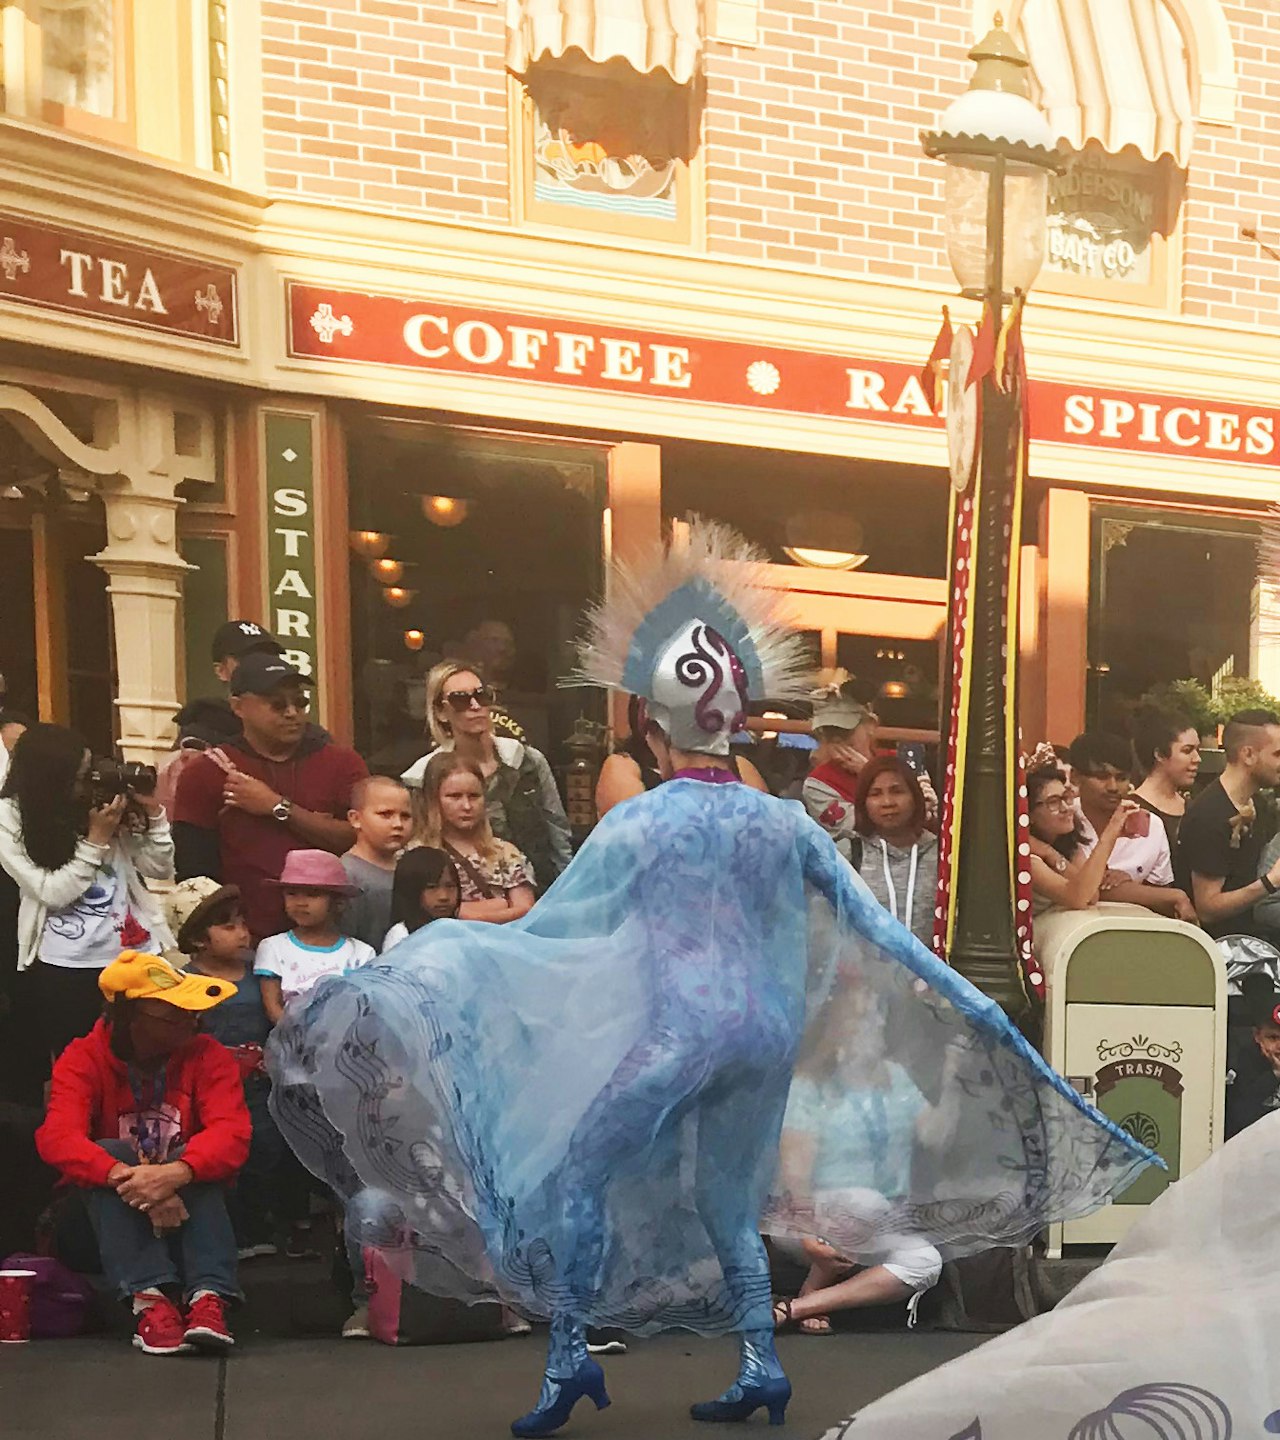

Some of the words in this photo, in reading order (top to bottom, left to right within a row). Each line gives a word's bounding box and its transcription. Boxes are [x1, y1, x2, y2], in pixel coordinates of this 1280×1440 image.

[59, 249, 169, 315] TEA
[402, 313, 693, 389] COFFEE
[1063, 394, 1275, 456] SPICES
[273, 488, 313, 714] STARB
[1114, 1063, 1164, 1078] TRASH
